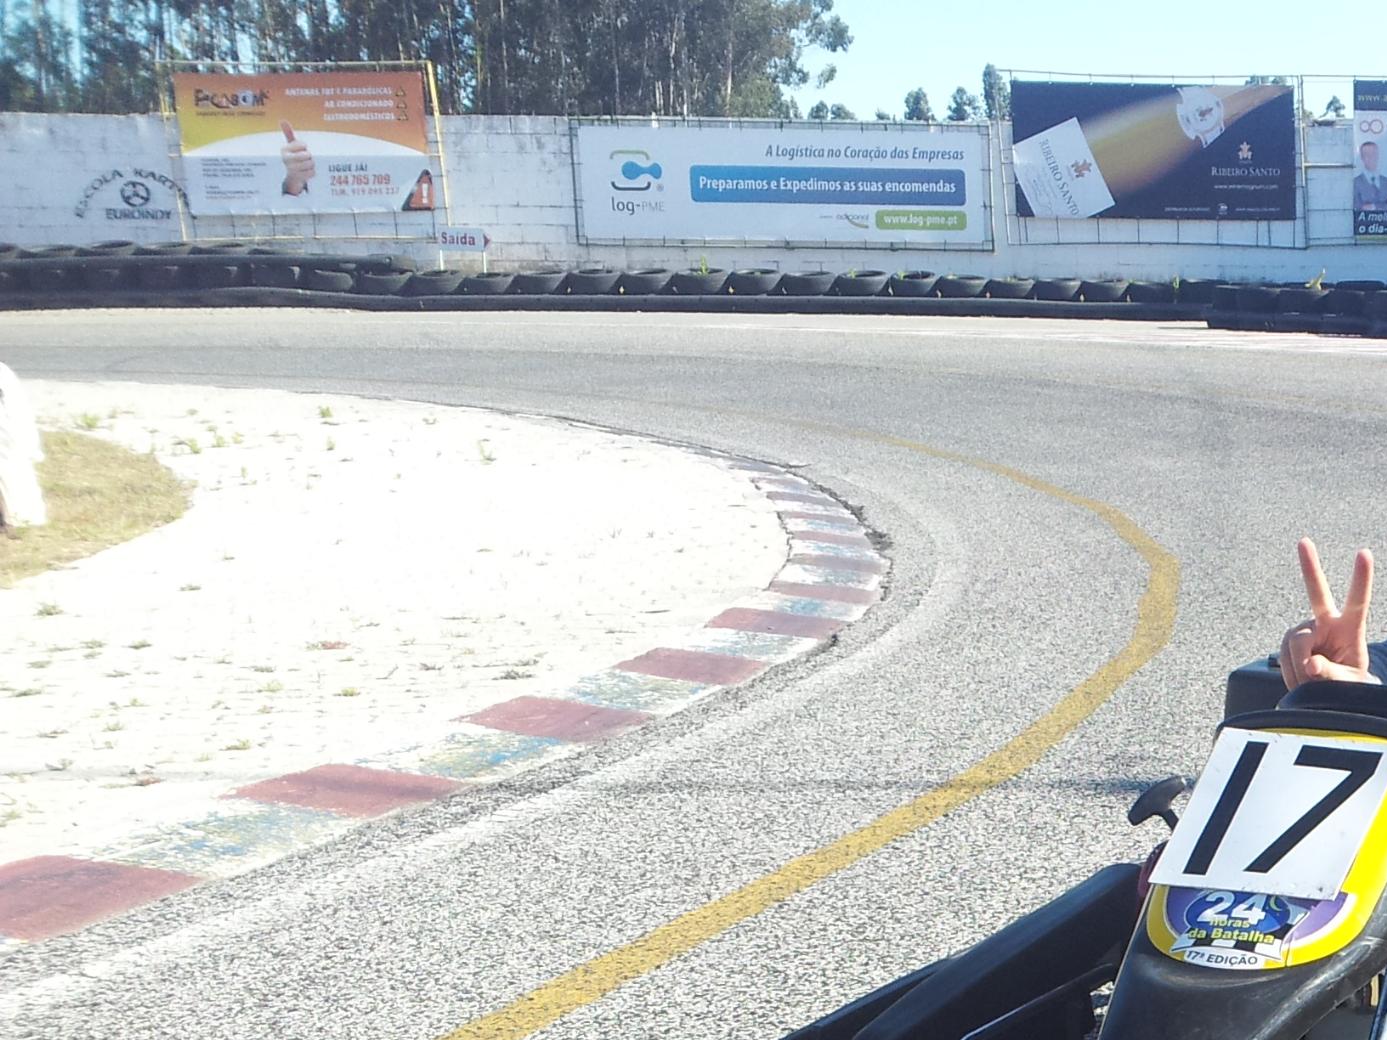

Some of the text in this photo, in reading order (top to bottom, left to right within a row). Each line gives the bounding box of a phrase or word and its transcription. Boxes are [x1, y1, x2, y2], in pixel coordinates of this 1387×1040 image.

[765, 145, 965, 163] A Logística no Coração das Empresas
[1249, 166, 1281, 177] SANTO
[699, 176, 956, 193] Preparamos e Expedimos as suas encomendas
[105, 208, 171, 220] EUROINDY
[883, 213, 958, 225] www.log-pme.pt
[1358, 212, 1366, 221] A
[440, 231, 476, 246] Saída
[1183, 741, 1384, 876] 17
[1197, 890, 1268, 926] 24
[1187, 927, 1275, 945] da Batalha
[1186, 950, 1258, 967] 17ª EDIÇÃO
